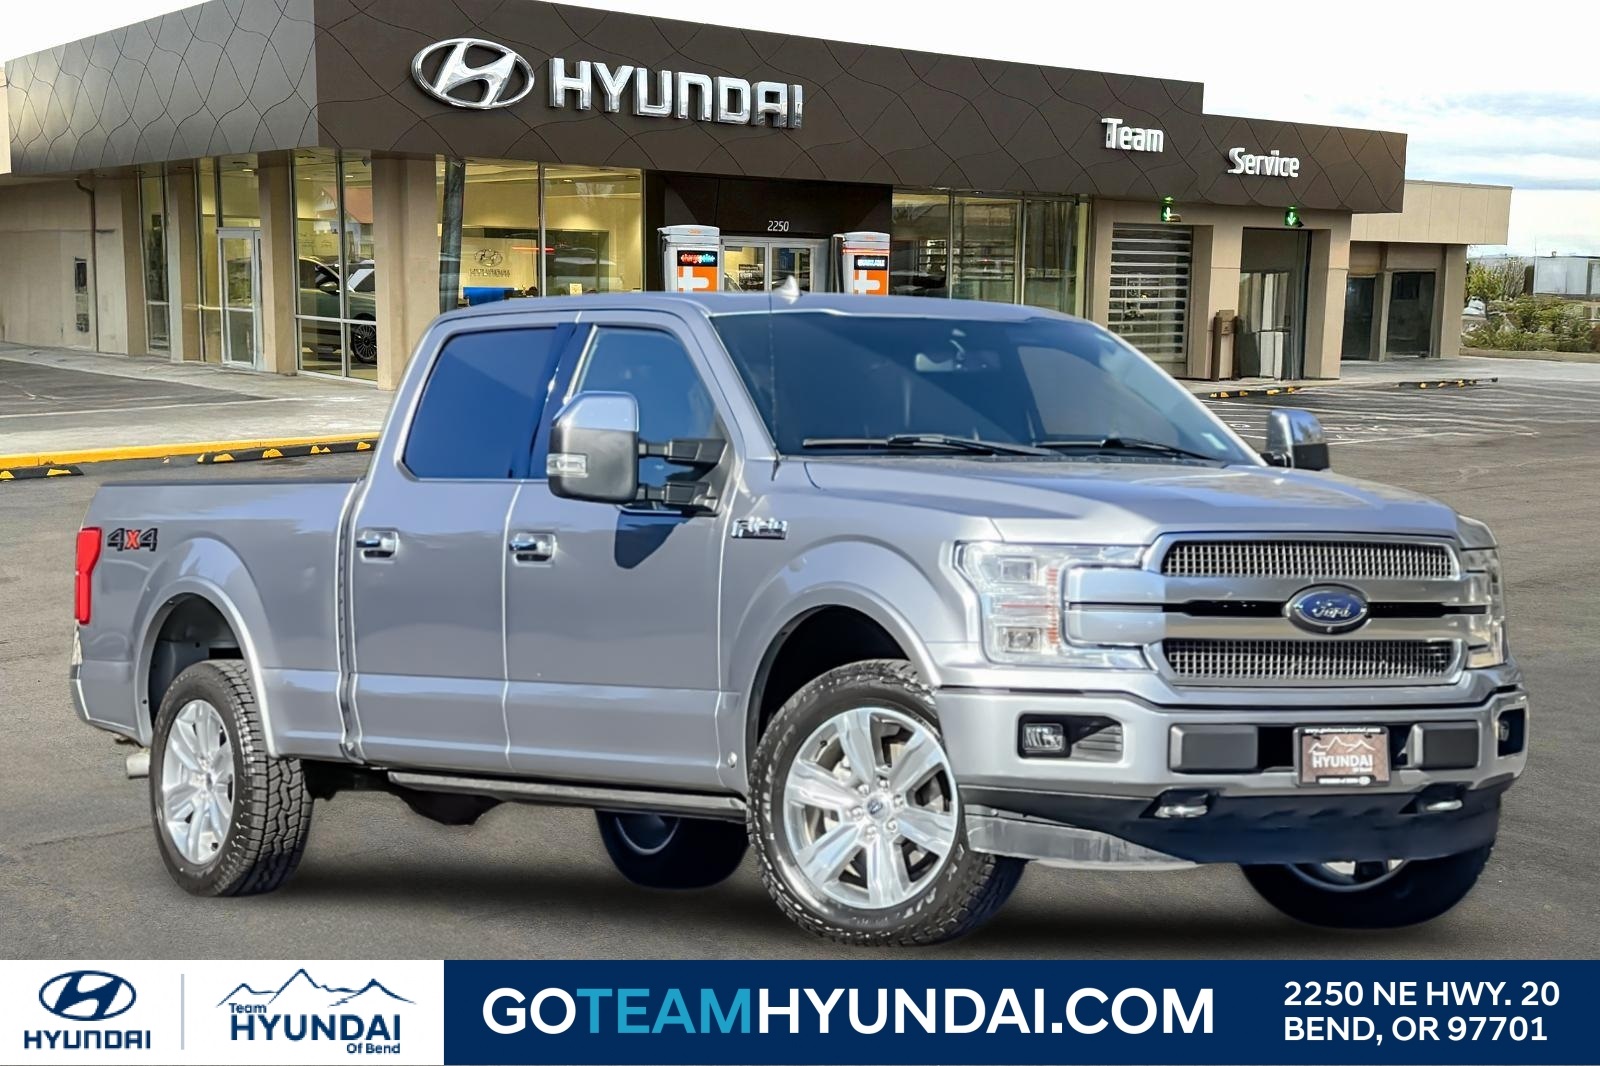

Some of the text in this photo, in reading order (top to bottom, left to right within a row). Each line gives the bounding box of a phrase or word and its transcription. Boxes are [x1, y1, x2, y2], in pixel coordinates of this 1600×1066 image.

[549, 57, 803, 128] HYUNDAI
[1101, 118, 1164, 153] Team
[1227, 147, 1300, 178] Service
[767, 220, 790, 232] 2250
[1311, 601, 1352, 618] Ford
[1312, 754, 1373, 768] HYUNDAI
